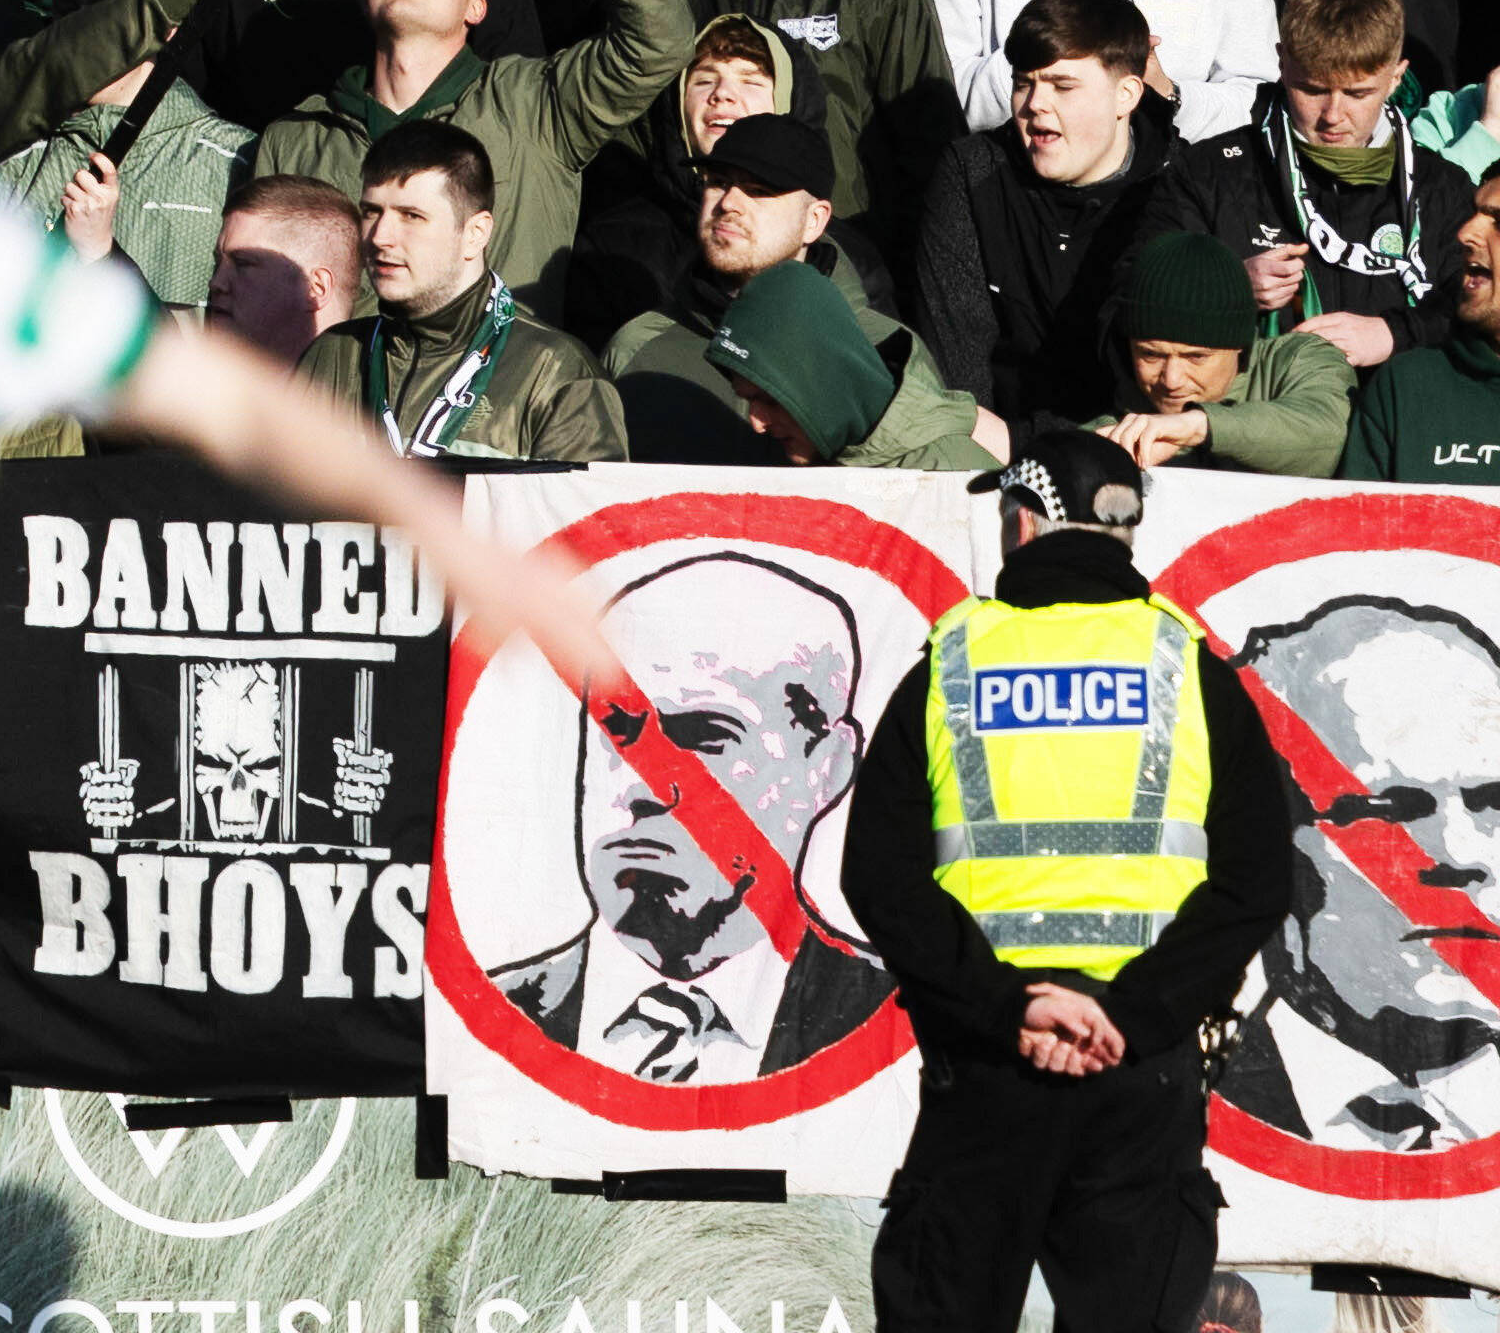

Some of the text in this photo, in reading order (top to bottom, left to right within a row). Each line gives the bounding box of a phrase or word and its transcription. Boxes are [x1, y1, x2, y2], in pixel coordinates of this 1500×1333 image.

[21, 513, 452, 639] BANNED
[979, 671, 1145, 727] POLICE
[28, 849, 432, 1001] BHOYS
